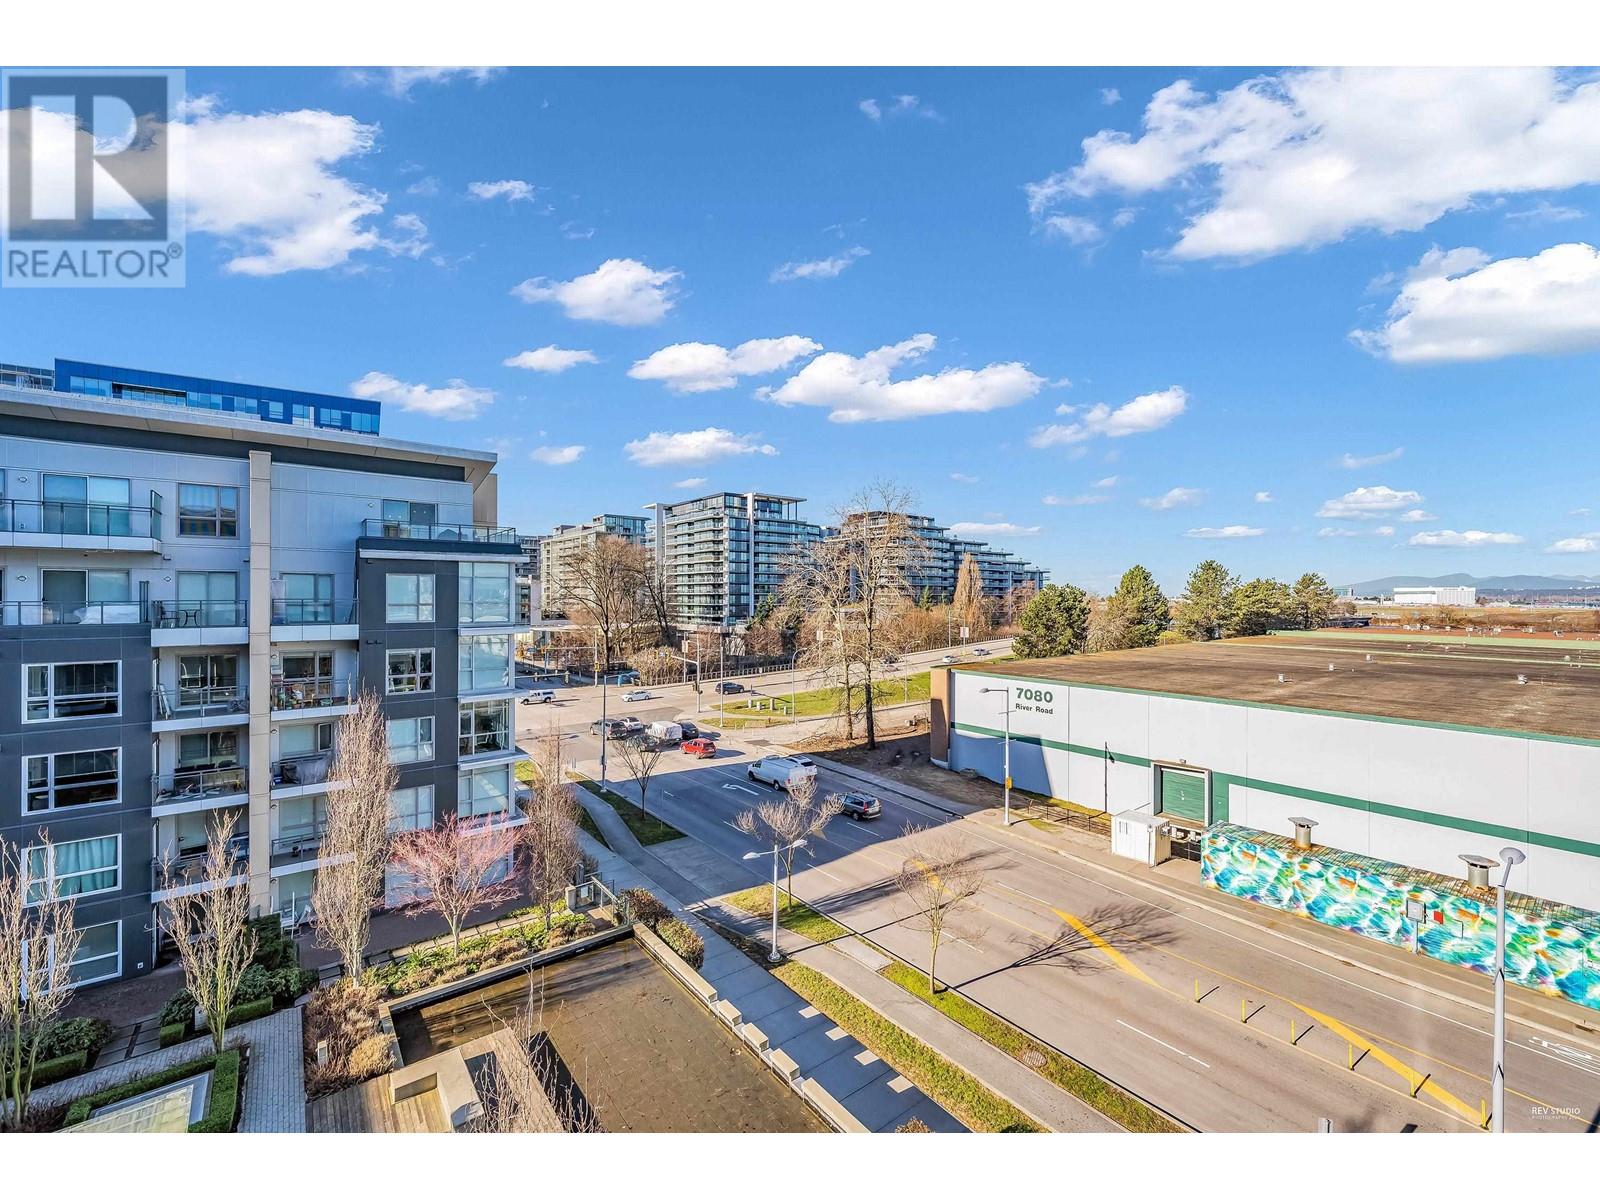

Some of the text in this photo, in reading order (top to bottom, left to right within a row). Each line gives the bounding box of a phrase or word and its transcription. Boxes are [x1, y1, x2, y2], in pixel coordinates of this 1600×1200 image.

[1016, 687, 1053, 703] 7080
[1015, 703, 1053, 714] River Road
